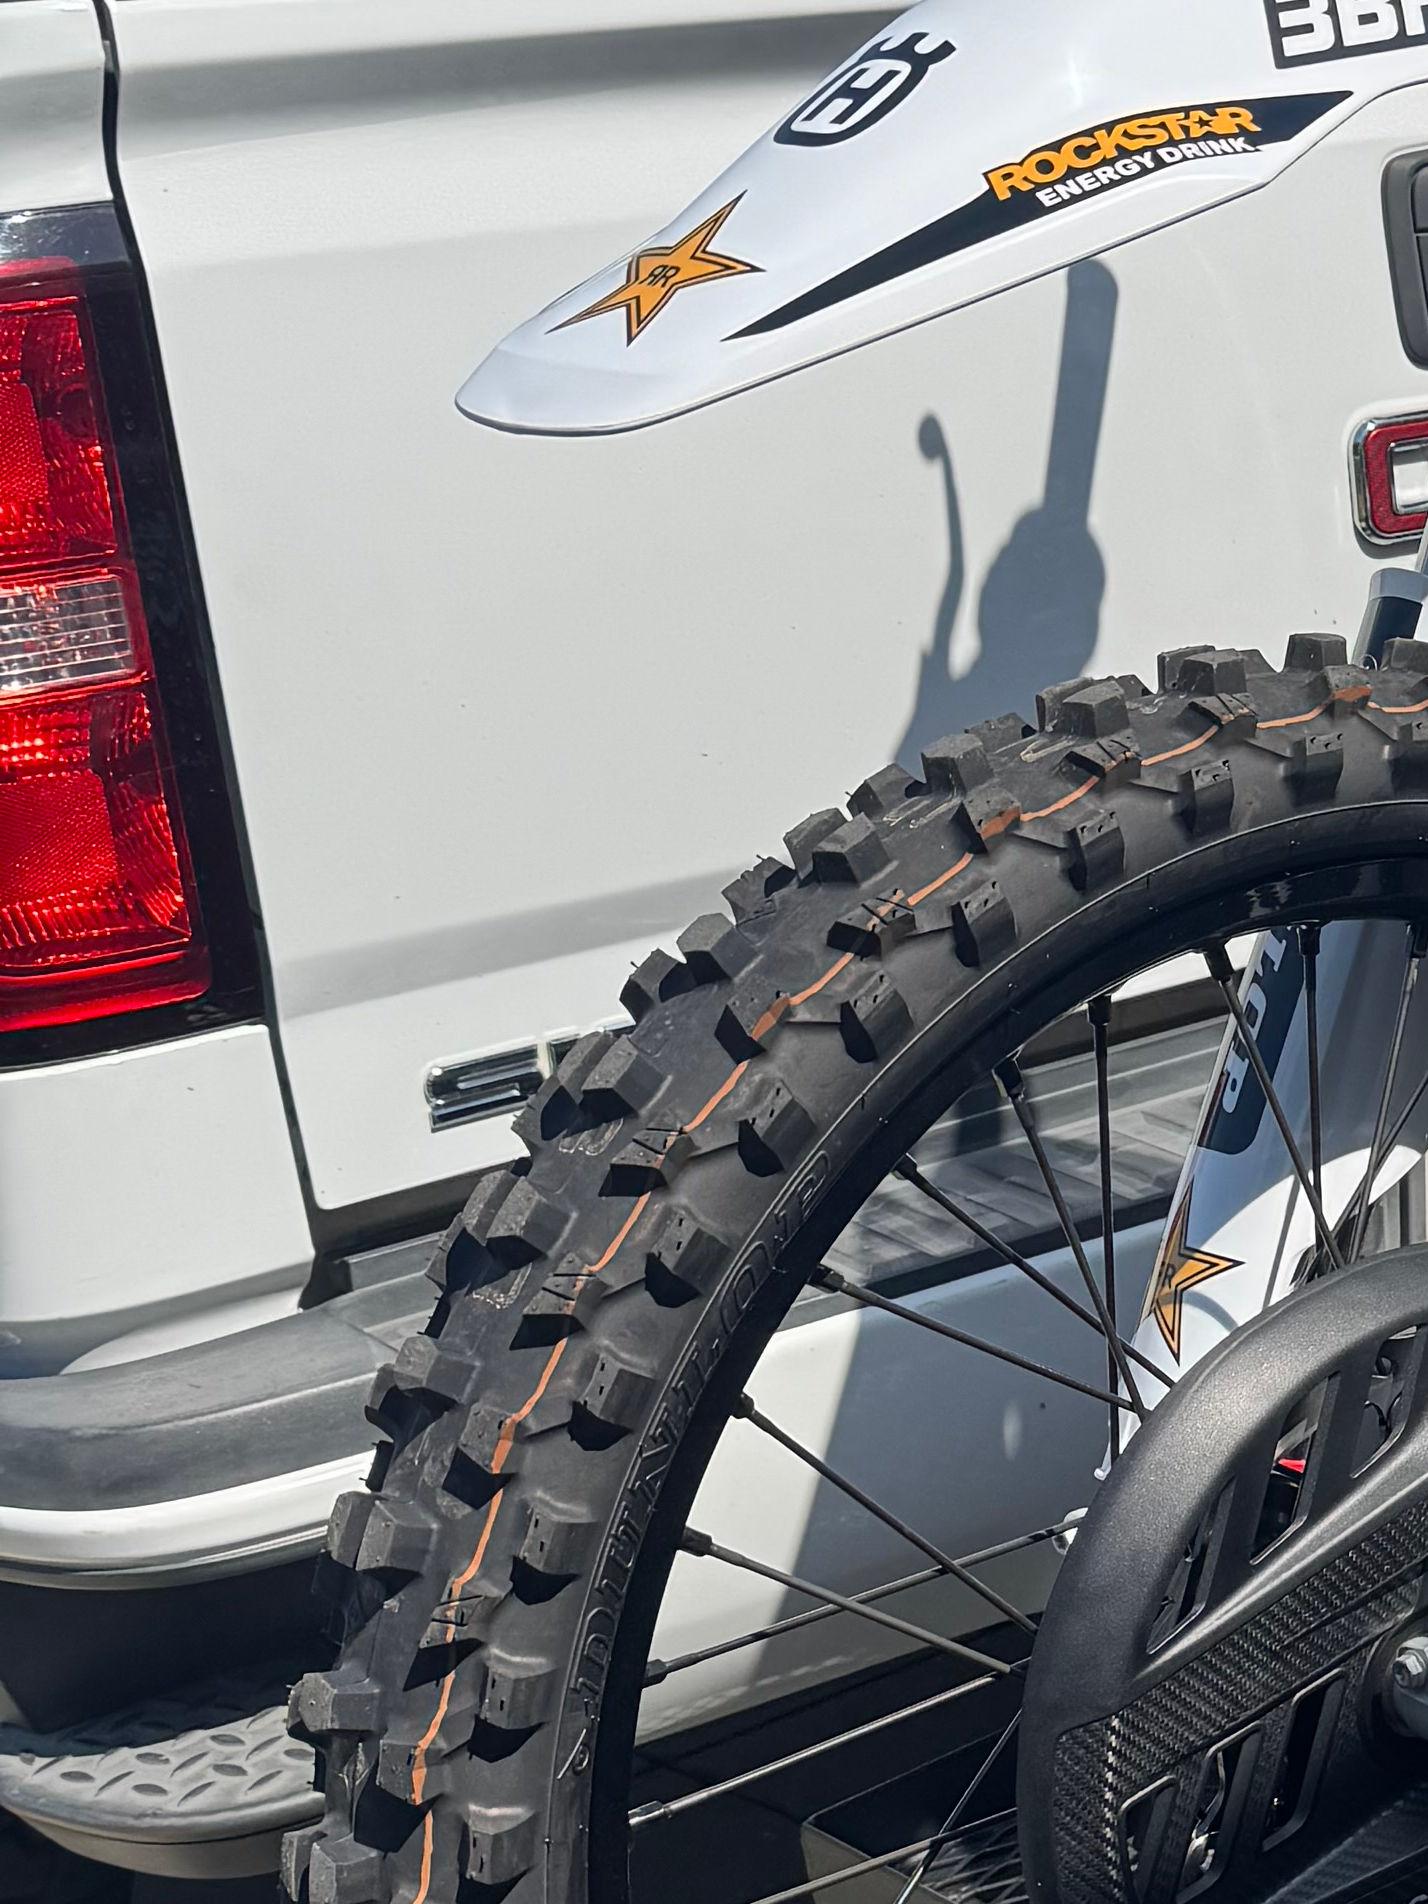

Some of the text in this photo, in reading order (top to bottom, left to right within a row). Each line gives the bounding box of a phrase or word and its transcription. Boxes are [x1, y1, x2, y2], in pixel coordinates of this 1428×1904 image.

[987, 106, 1263, 201] ROCKSTAR
[1035, 136, 1256, 208] ENERGY DRINK
